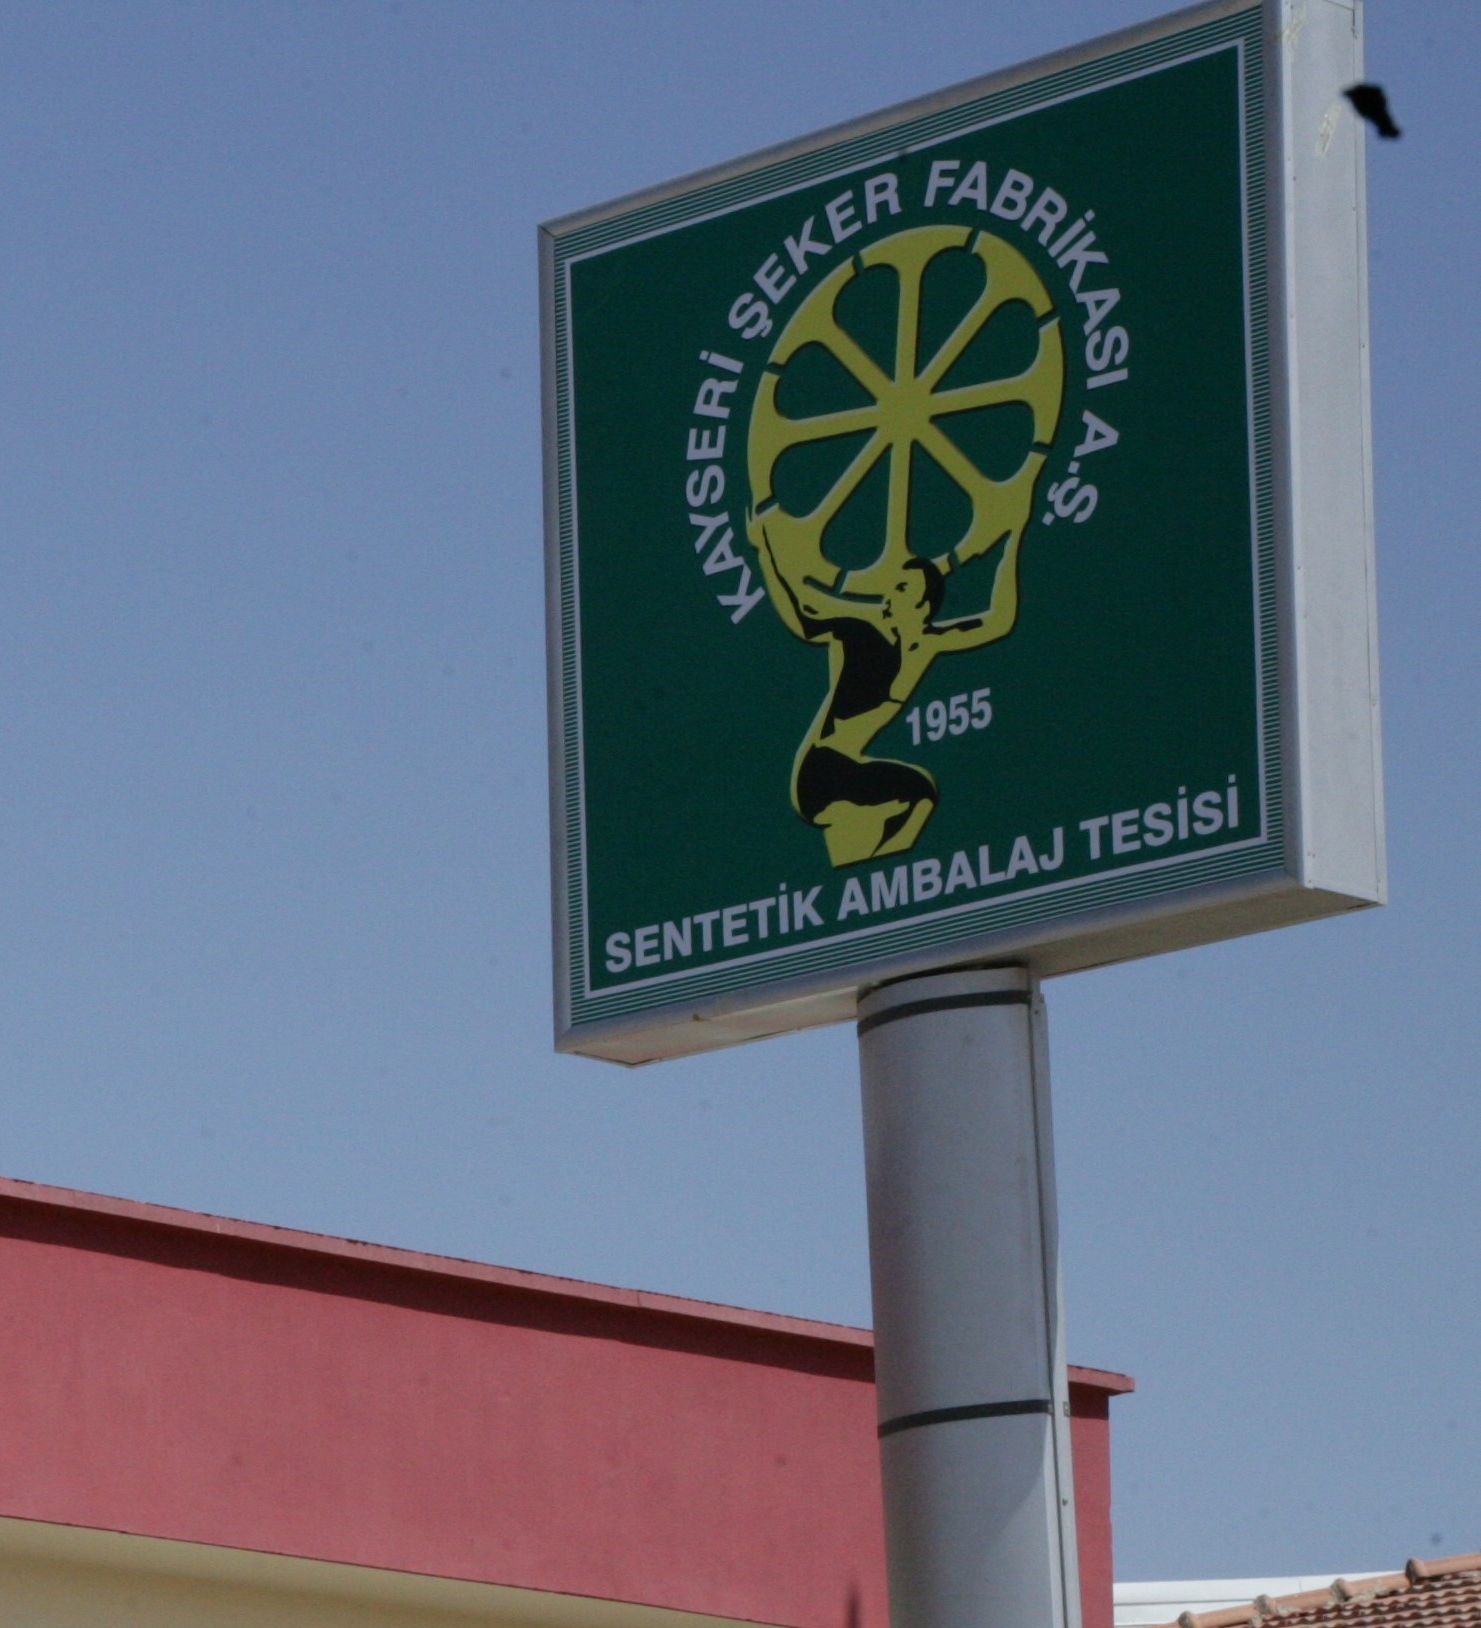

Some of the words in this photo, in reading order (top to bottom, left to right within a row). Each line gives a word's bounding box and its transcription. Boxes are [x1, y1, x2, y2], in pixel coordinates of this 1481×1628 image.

[685, 349, 766, 625] KAYSERİ
[727, 171, 903, 340] ŞEKER
[923, 160, 1130, 390] FABRİKASI
[905, 687, 993, 746] 1955
[604, 881, 825, 973] SENTETİK
[836, 827, 1065, 921] AMBALAJ
[1079, 773, 1240, 861] TESİSİ
